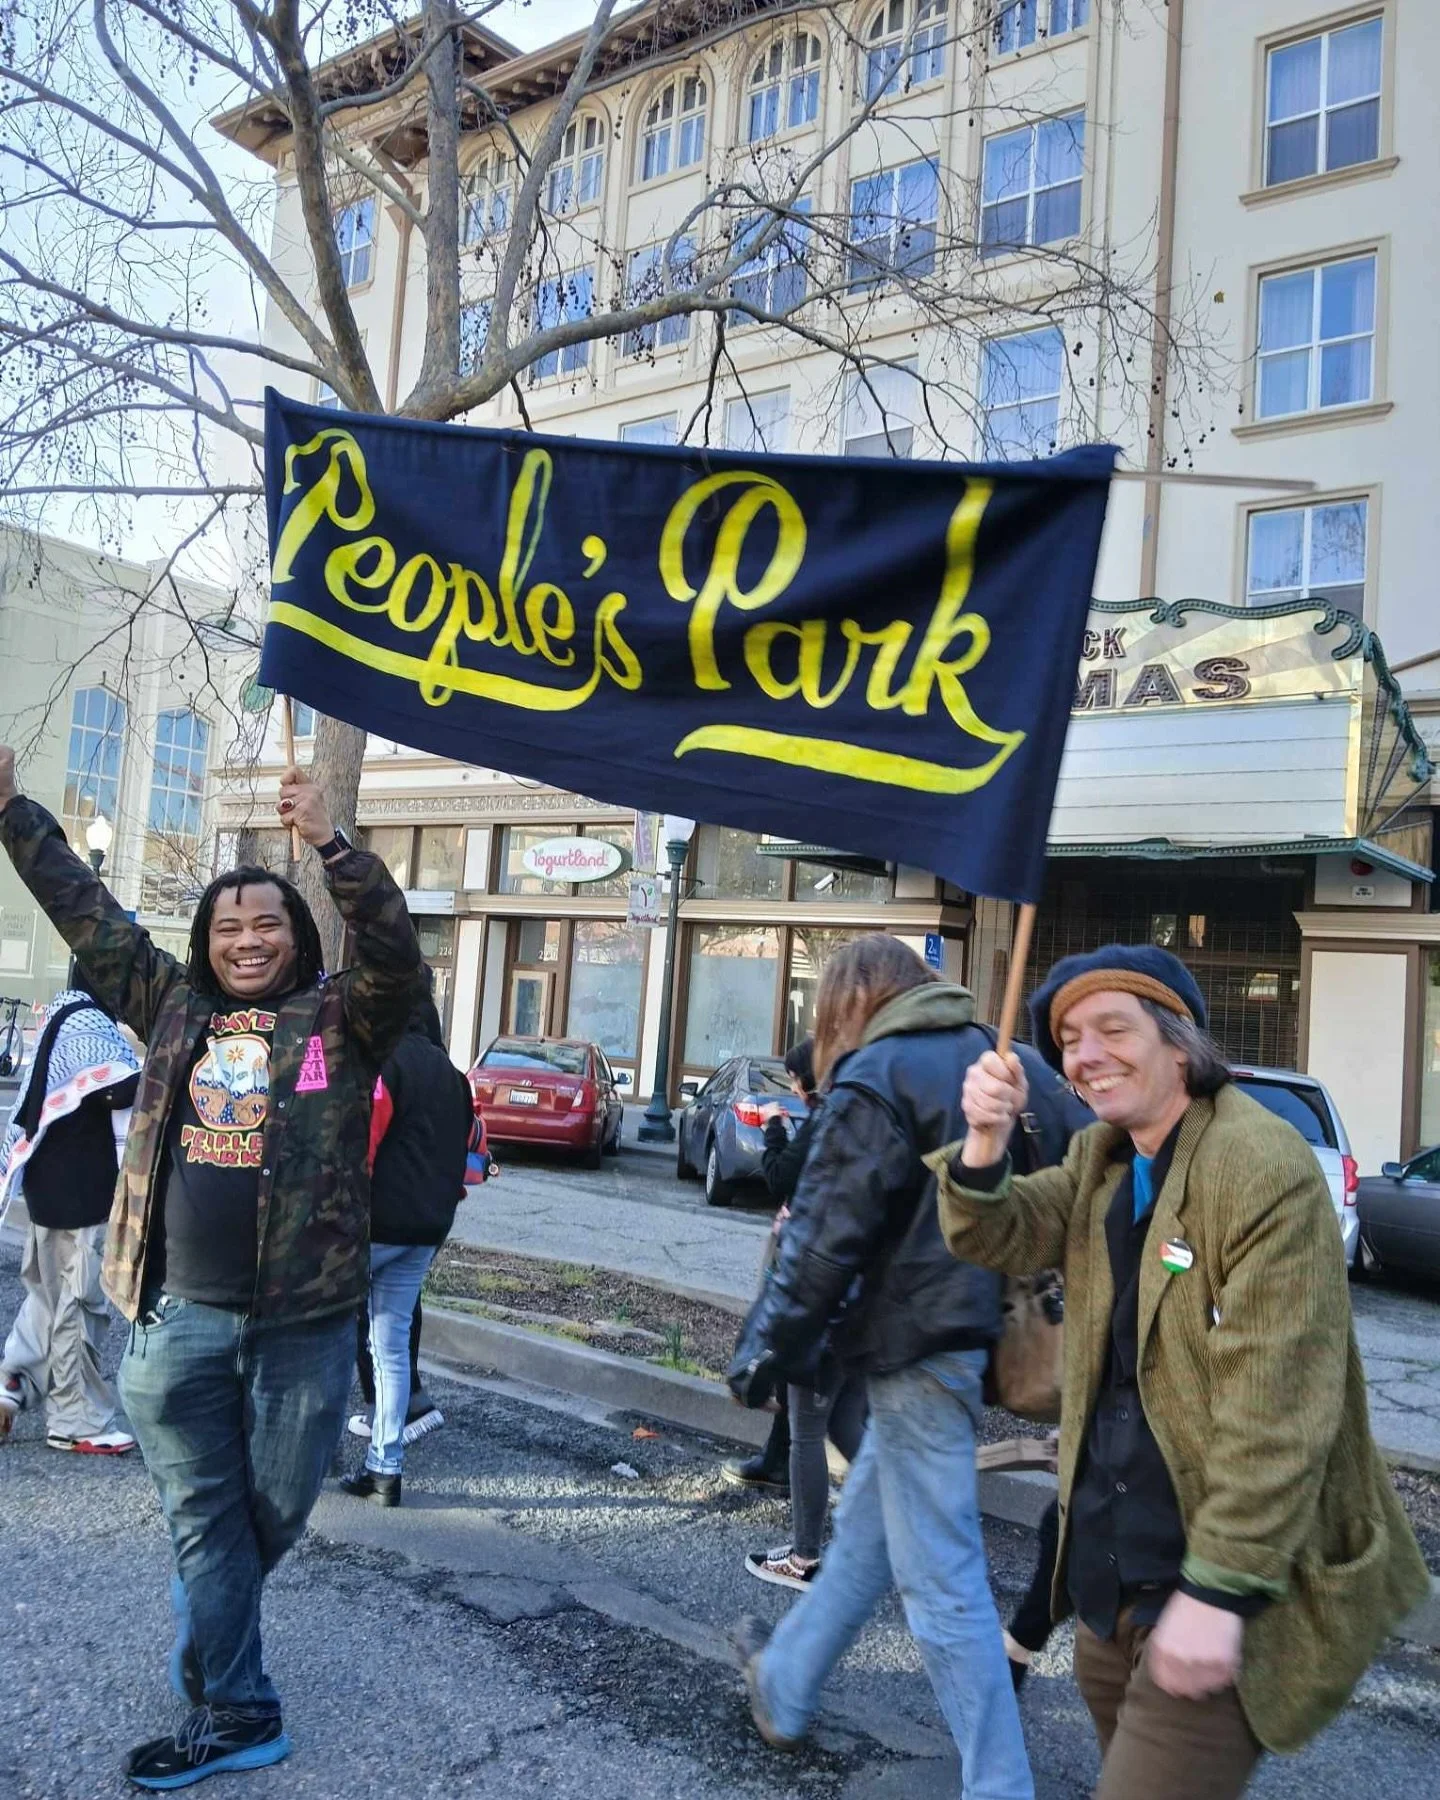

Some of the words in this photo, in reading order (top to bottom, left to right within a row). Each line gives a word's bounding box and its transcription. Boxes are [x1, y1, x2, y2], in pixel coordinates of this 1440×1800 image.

[270, 428, 643, 710] People's
[659, 470, 1026, 793] Park
[531, 847, 610, 876] Yogurtland
